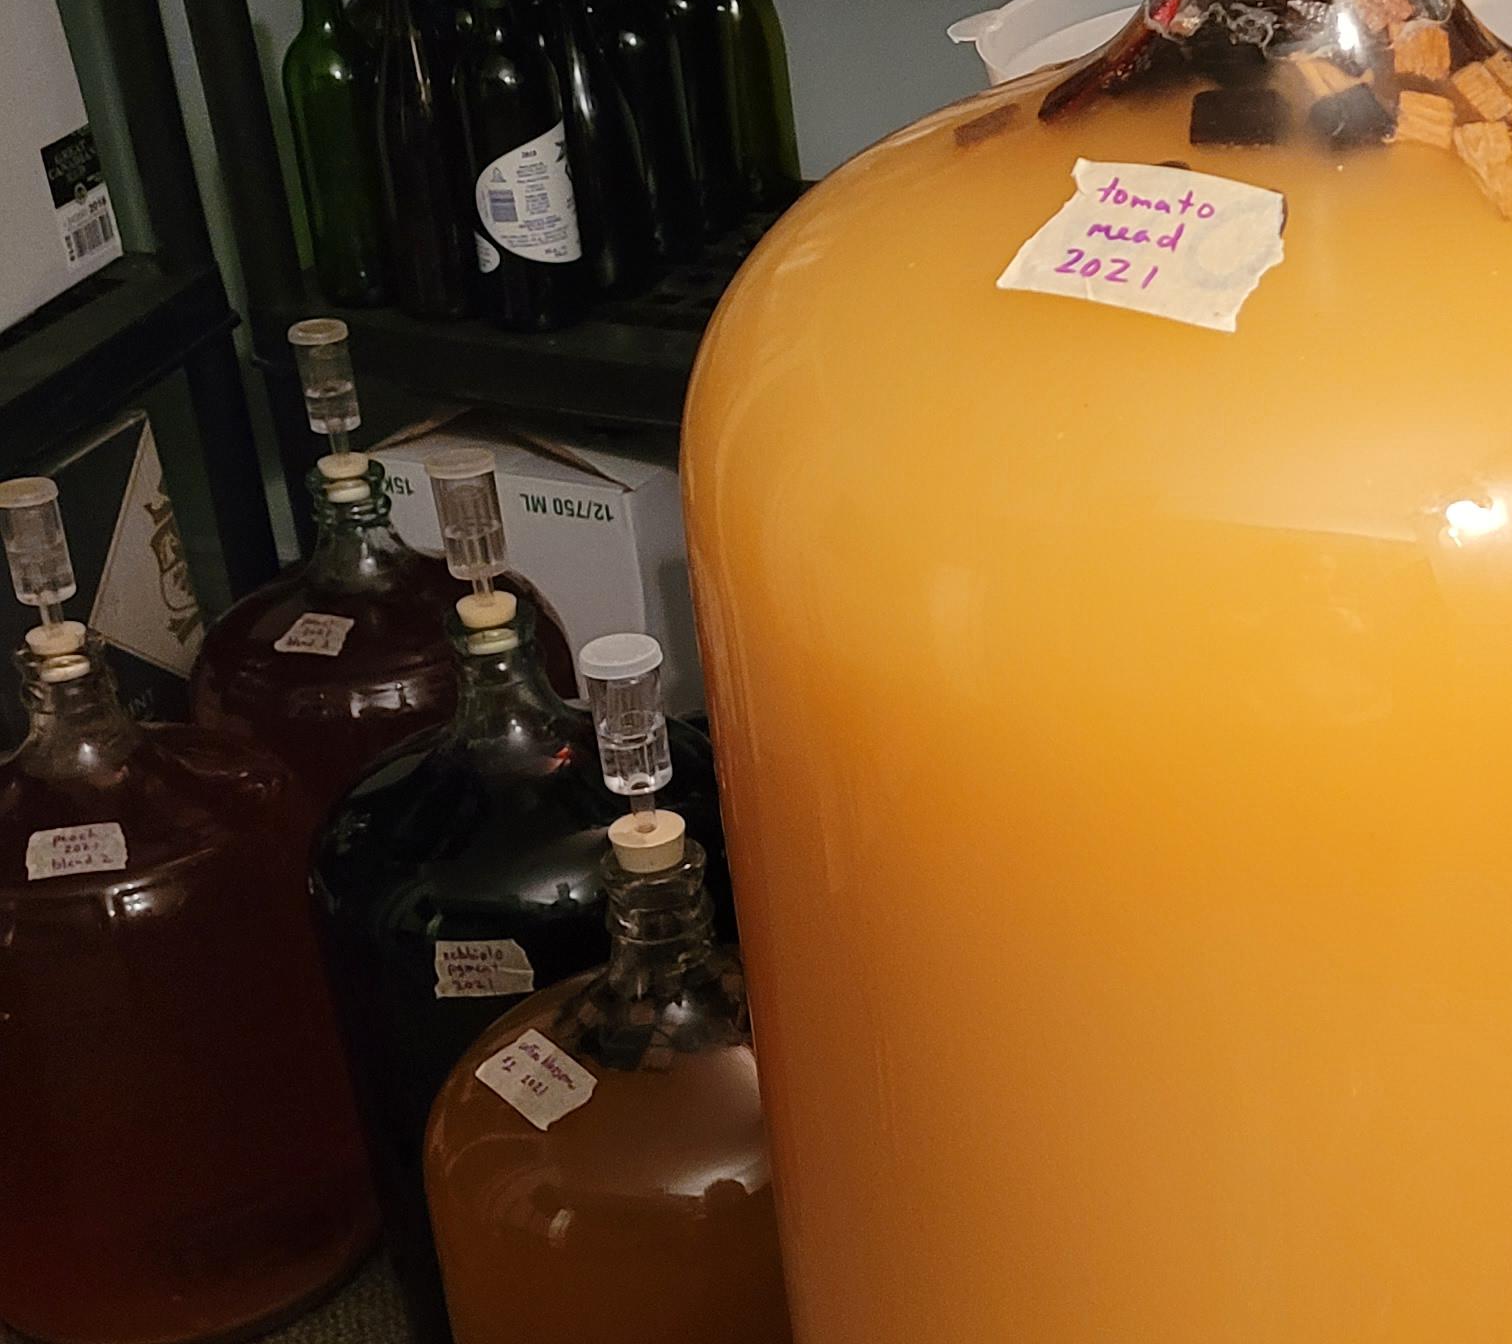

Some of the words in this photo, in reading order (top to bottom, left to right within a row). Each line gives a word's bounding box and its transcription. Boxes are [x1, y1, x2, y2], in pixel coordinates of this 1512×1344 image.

[1096, 177, 1216, 219] tomato
[1087, 223, 1185, 253] mead
[1054, 248, 1159, 289] 2021
[520, 493, 547, 514] ML
[553, 497, 614, 522] 12/750
